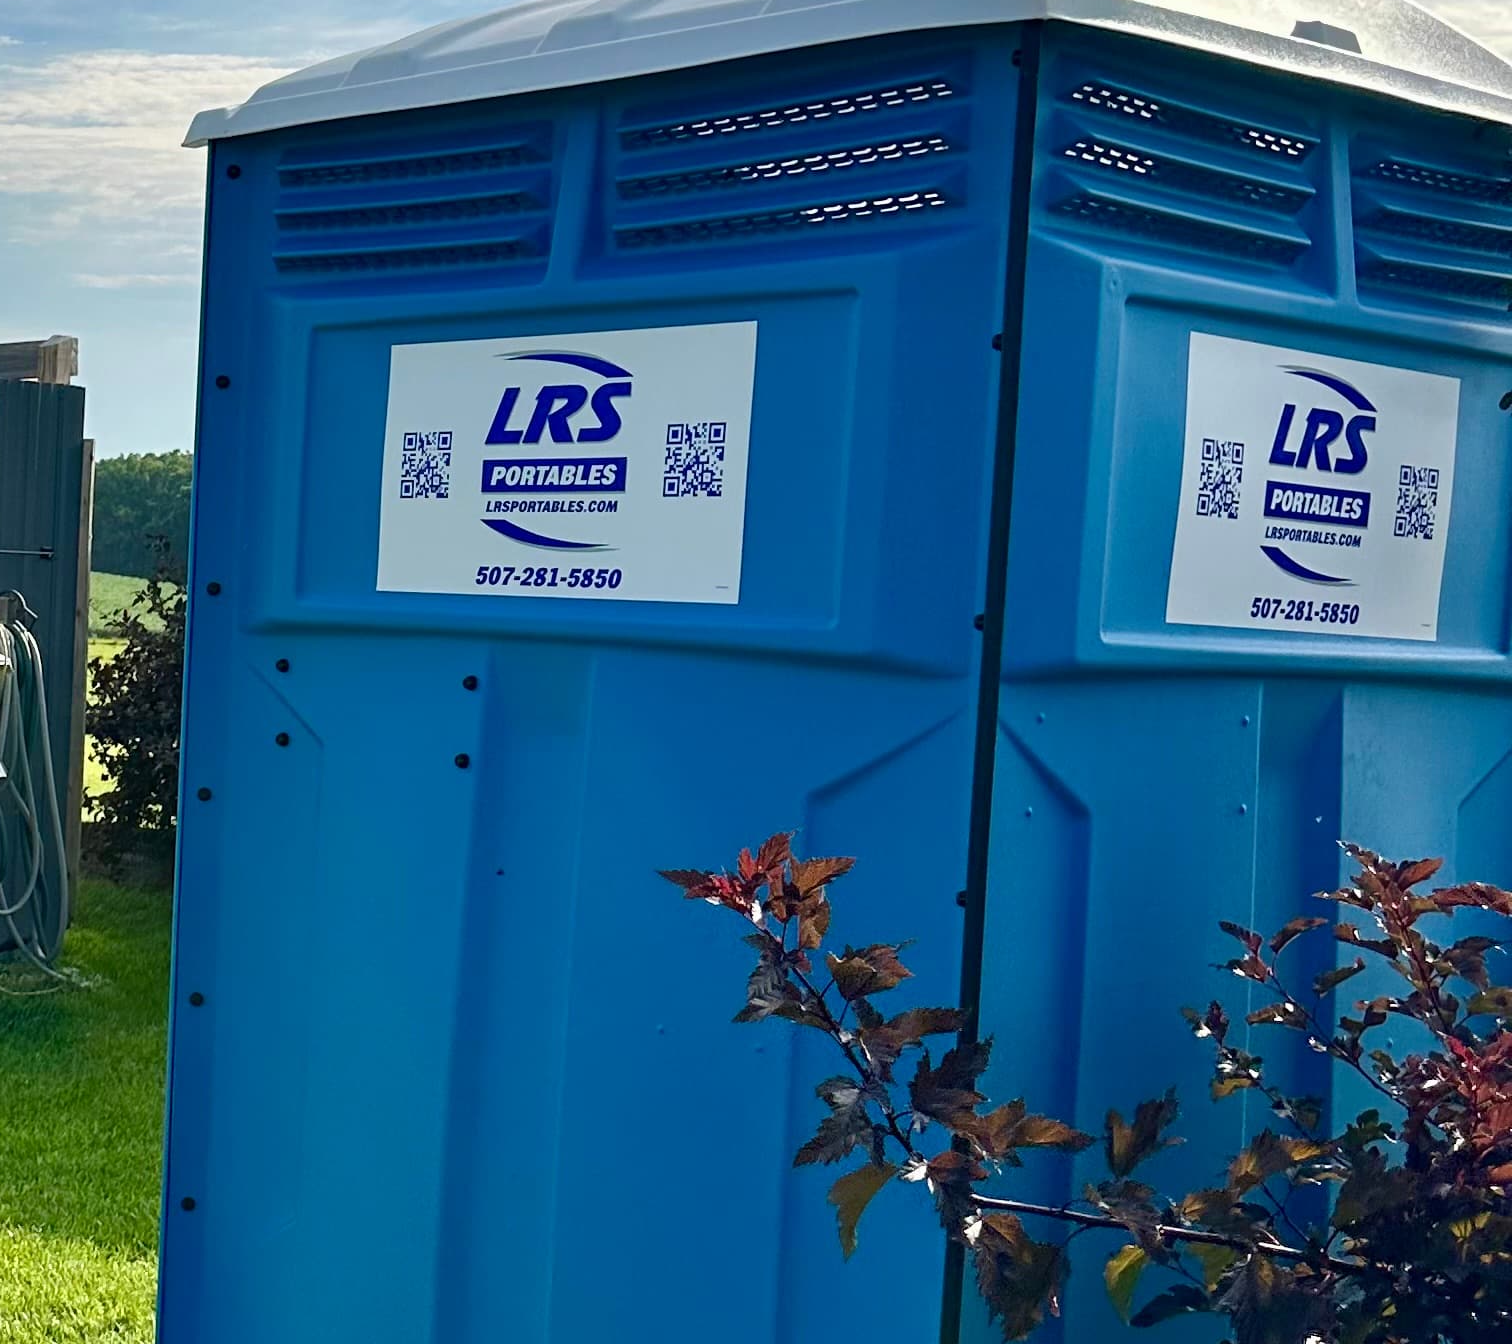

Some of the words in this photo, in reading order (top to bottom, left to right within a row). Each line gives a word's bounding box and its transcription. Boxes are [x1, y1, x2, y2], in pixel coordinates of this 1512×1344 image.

[484, 381, 633, 446] LRS
[1268, 403, 1377, 475] LRS
[490, 463, 618, 486] PORTABLES
[485, 500, 619, 513] LRSPORTABLES.COM
[1269, 488, 1364, 520] PORTABLES
[1264, 526, 1362, 548] LRSPORTABLES.COM
[475, 565, 623, 590] 507-281-5850
[1250, 597, 1360, 625] 507-281-5850
